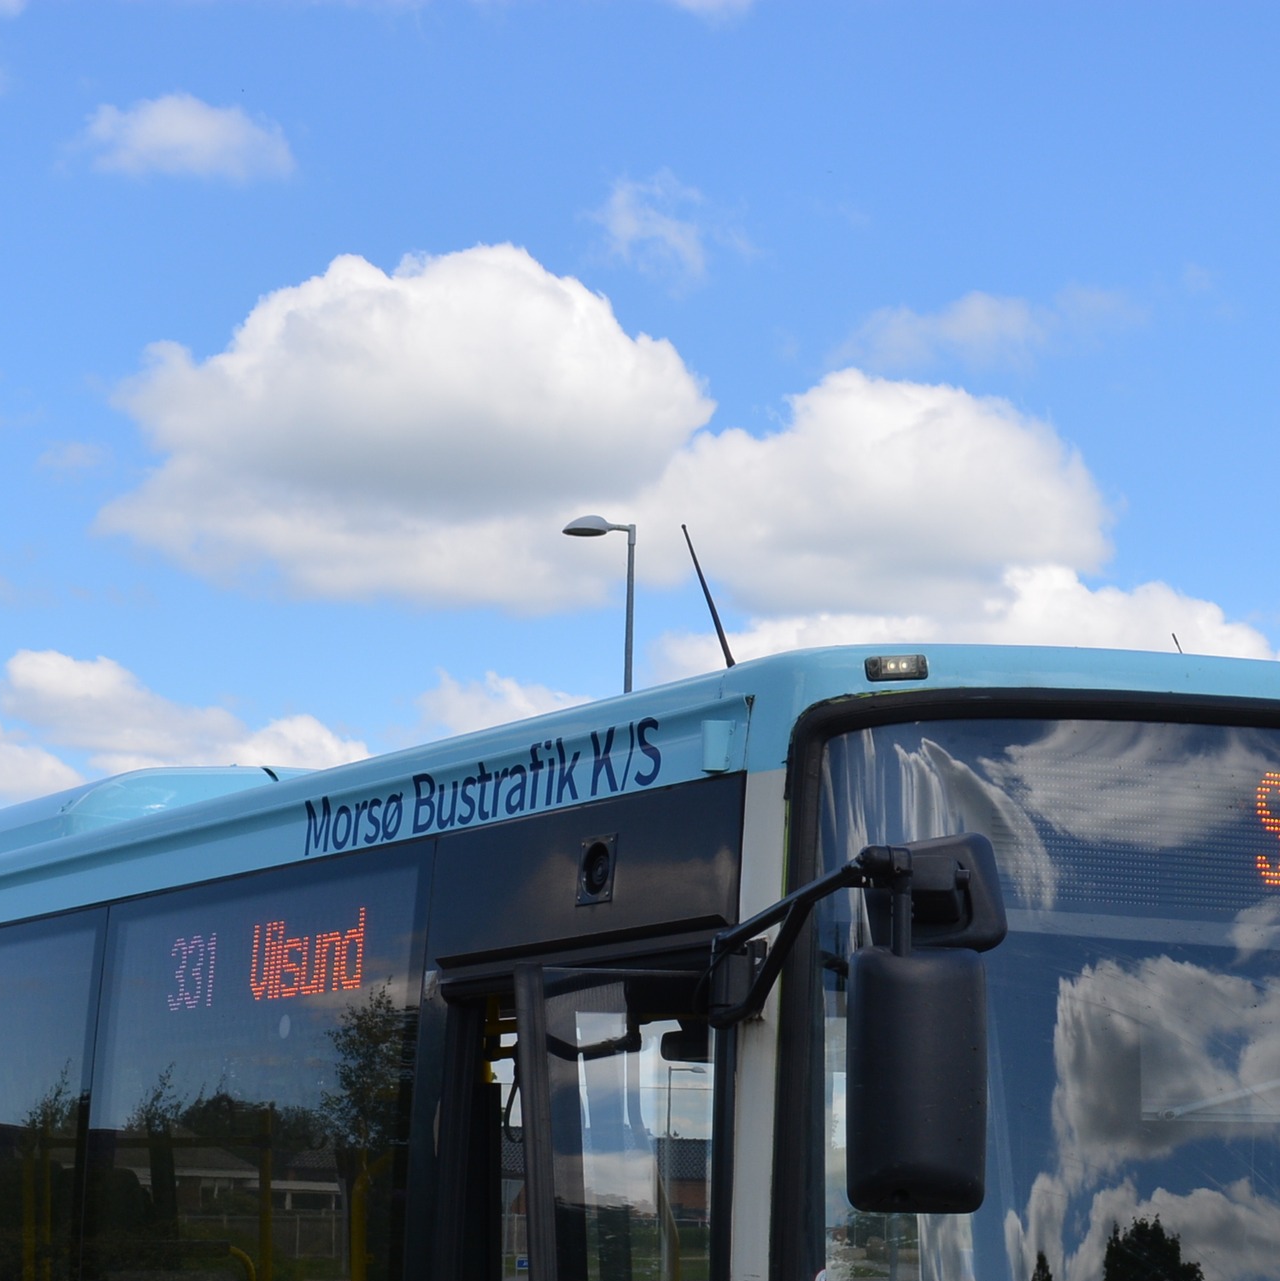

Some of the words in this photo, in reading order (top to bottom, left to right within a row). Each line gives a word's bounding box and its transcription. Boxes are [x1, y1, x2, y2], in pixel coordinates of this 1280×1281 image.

[305, 791, 403, 857] Morsø
[412, 736, 581, 834] Bustrafik
[590, 716, 662, 798] K/S
[167, 932, 218, 1012] 331
[249, 906, 366, 1001] Vilsund
